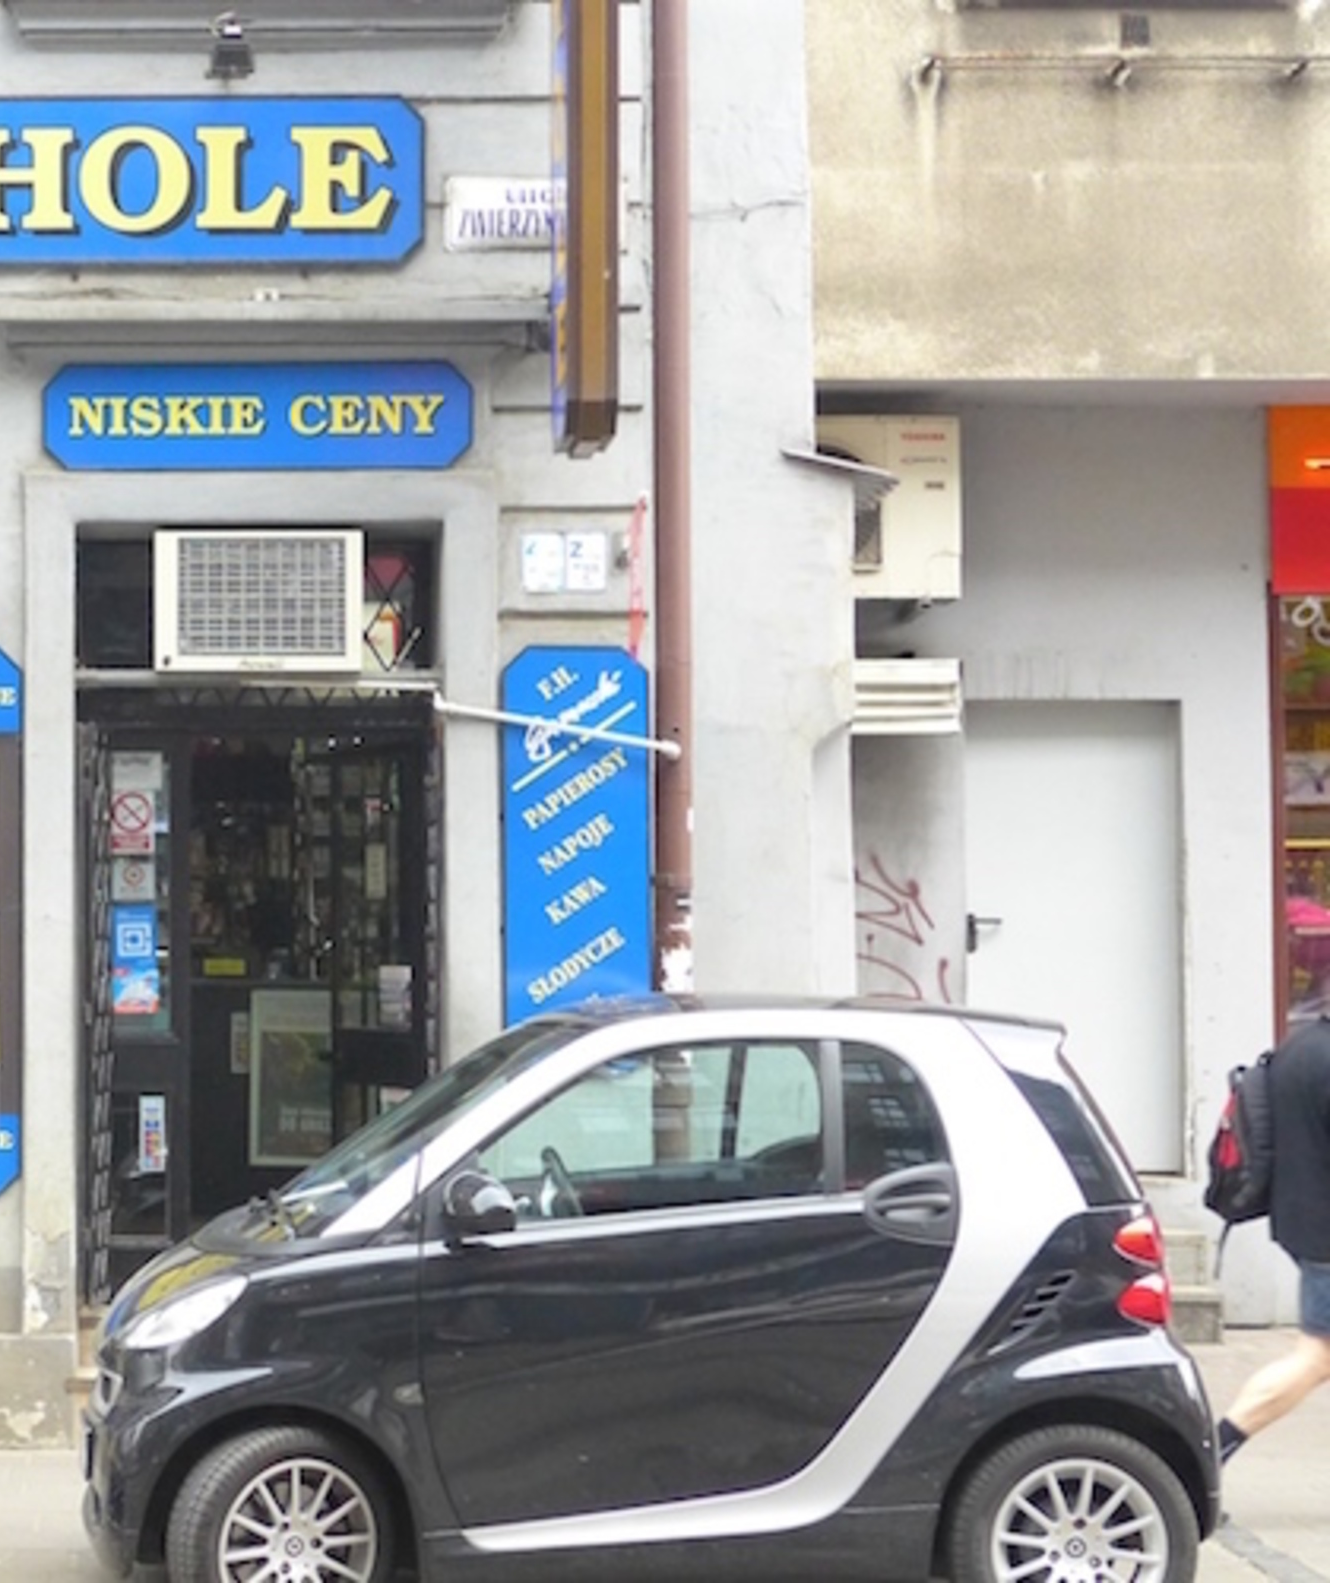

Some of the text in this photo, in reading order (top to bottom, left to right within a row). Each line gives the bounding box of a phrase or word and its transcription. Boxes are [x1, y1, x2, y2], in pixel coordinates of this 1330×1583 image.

[68, 394, 445, 438] NISKIE CENY
[521, 746, 628, 831] PAPIEROSY
[537, 812, 615, 876] NAPOJE
[543, 875, 608, 925] KAWA
